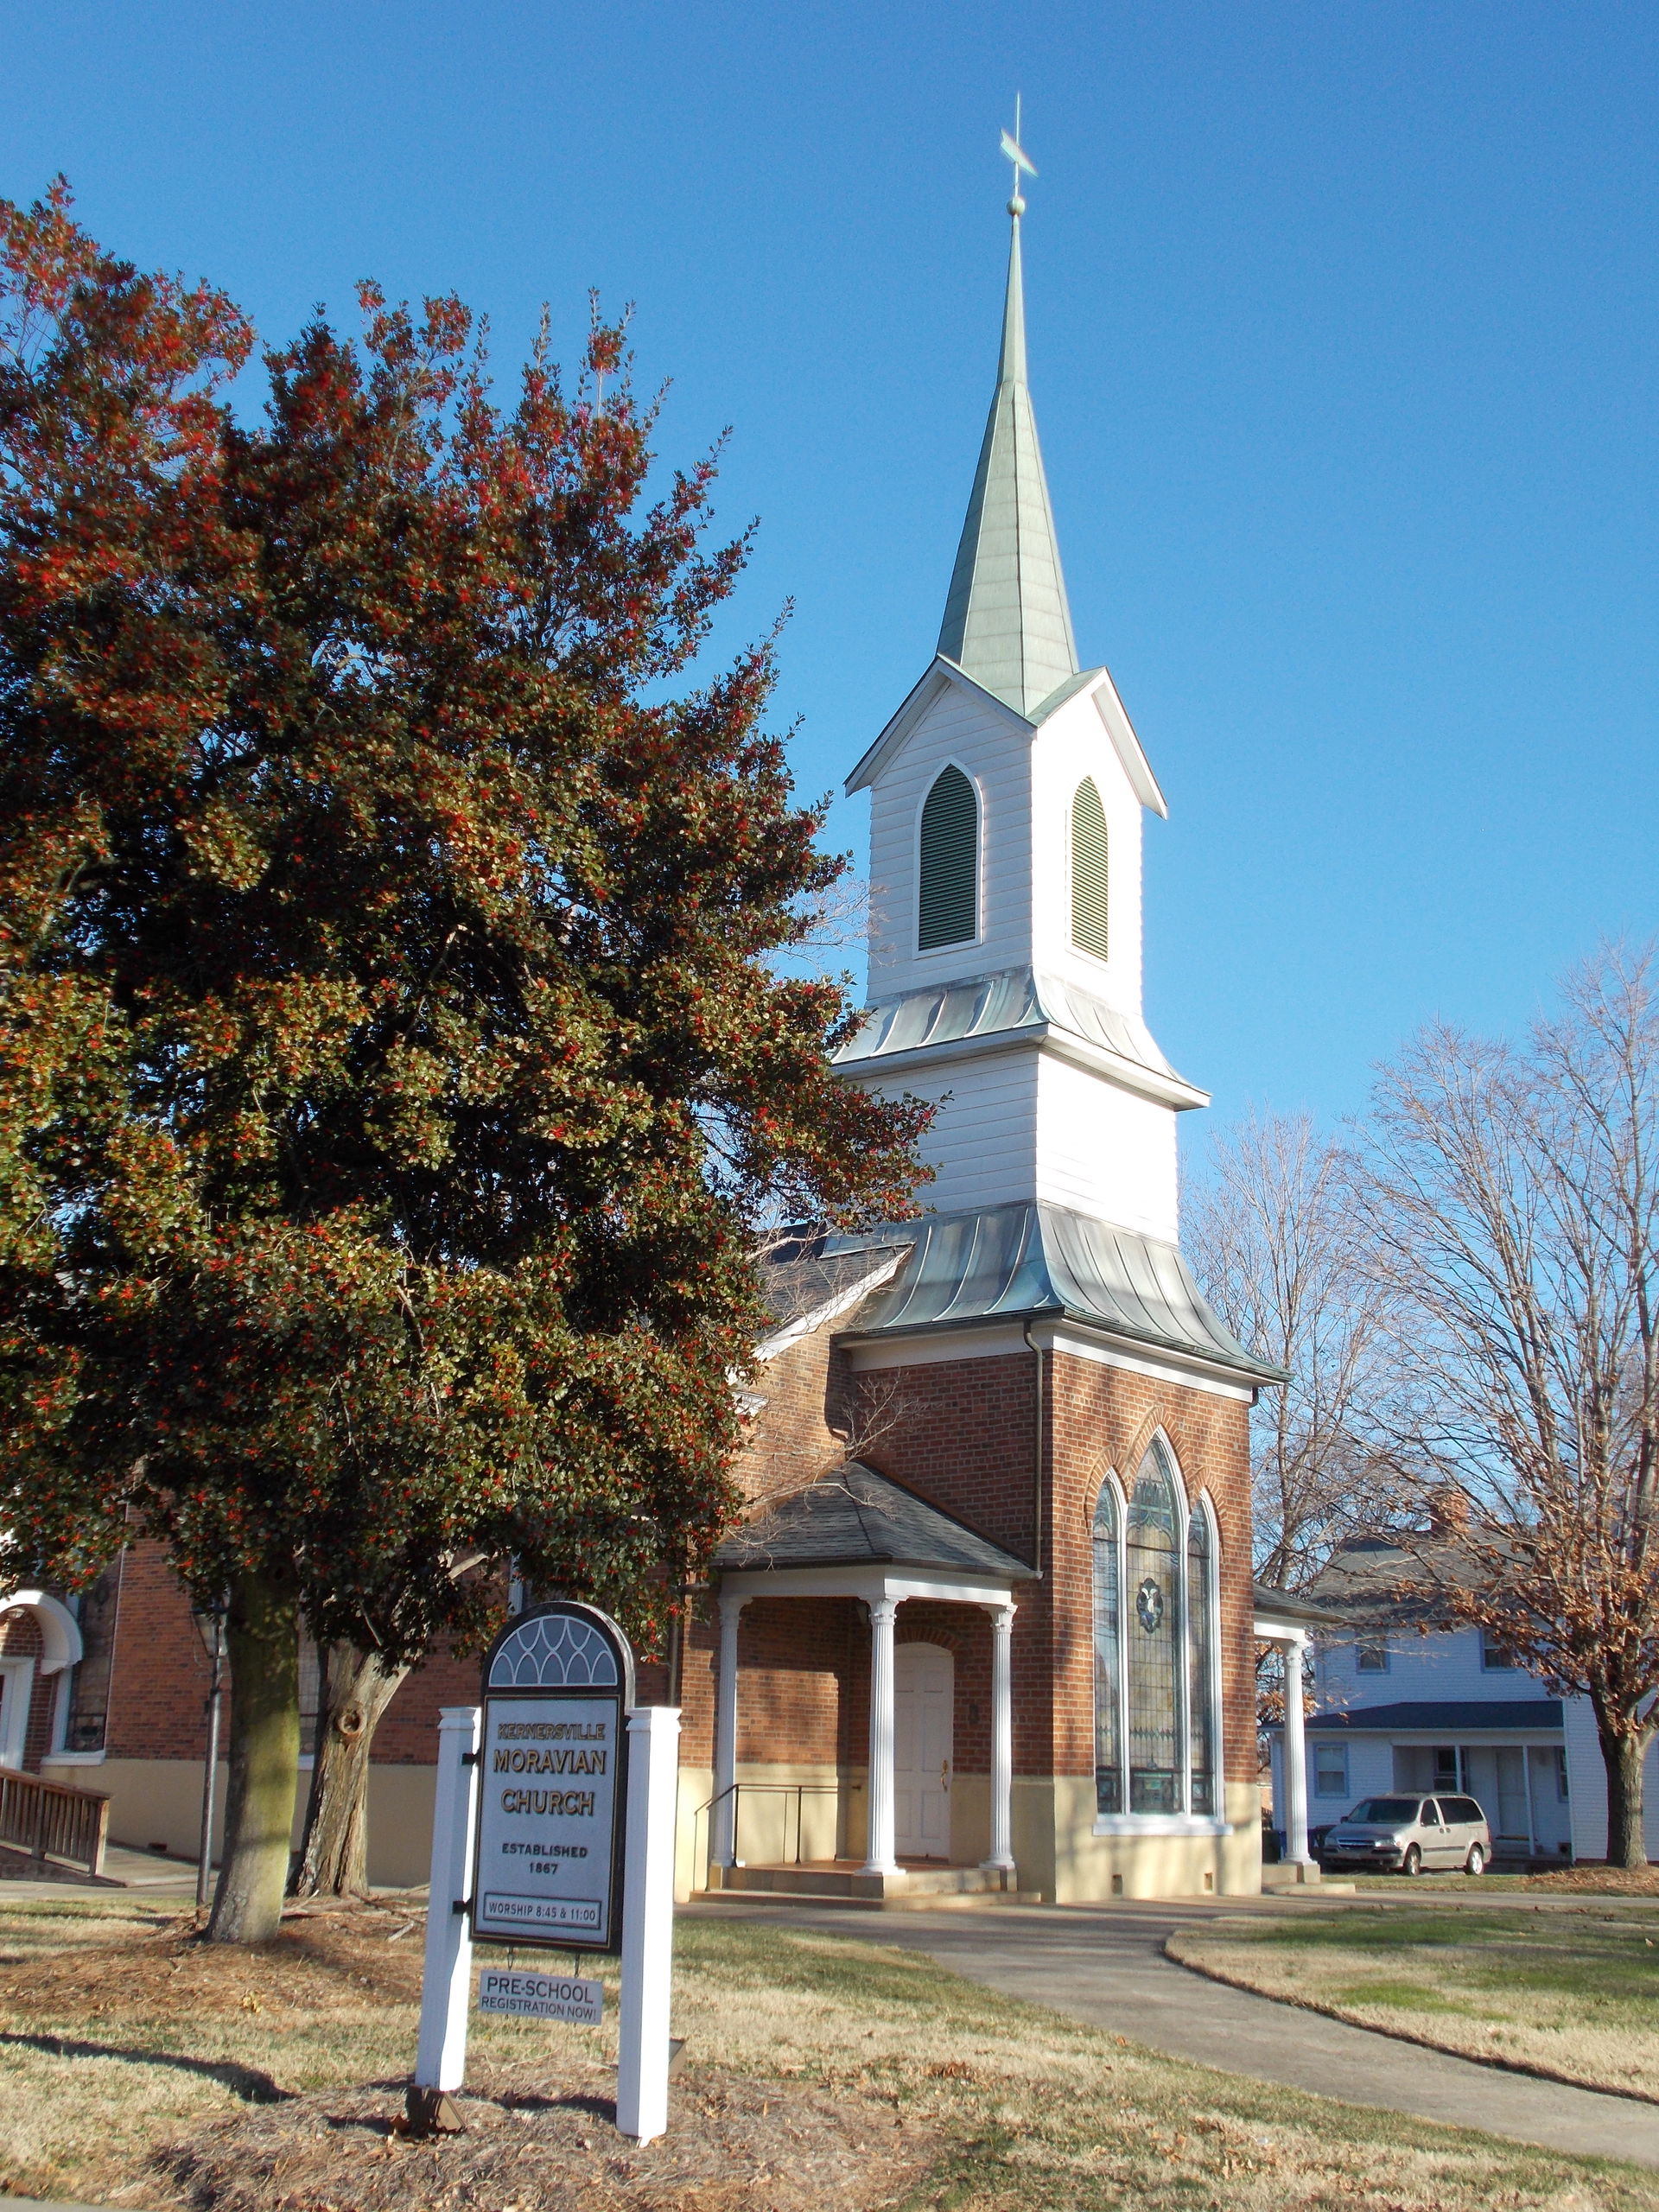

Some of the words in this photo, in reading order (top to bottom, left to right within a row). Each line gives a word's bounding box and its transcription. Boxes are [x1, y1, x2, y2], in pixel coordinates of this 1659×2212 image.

[498, 1723, 606, 1740] KERNERSVILLE
[493, 1749, 606, 1775] MORAVIAN
[501, 1789, 594, 1816] CHURCH
[502, 1842, 588, 1858] ESTABLISHED
[529, 1863, 558, 1875] 1867
[489, 1903, 533, 1916] WORSHIP
[536, 1905, 556, 1919] 8:45
[560, 1908, 567, 1918] &
[570, 1908, 596, 1922] 11:00
[486, 1976, 594, 2004] PRE-SCHOOL
[481, 1997, 565, 2016] REGISTRATION
[567, 2007, 596, 2022] NOW!
